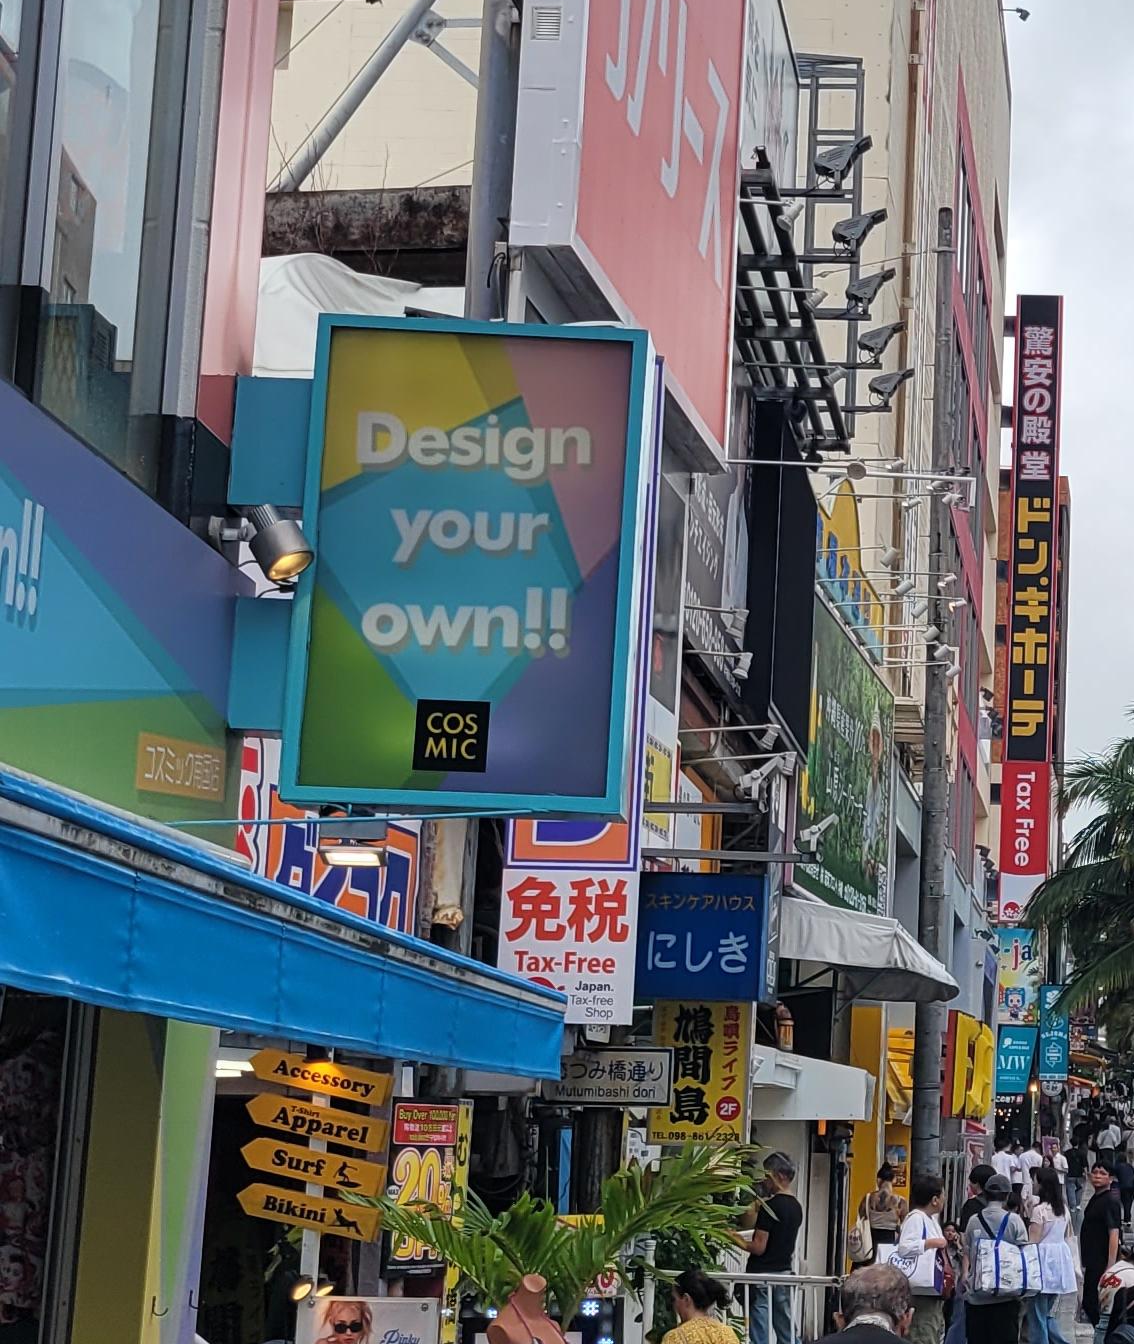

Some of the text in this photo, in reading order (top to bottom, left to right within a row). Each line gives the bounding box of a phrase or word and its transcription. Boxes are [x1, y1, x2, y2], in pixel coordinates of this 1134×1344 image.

[1019, 324, 1056, 482] 驚安の殿堂
[356, 410, 592, 482] Design
[390, 507, 550, 564] your
[360, 586, 569, 651] own!!
[426, 711, 479, 736] COS
[424, 736, 478, 761] MIC
[1014, 771, 1036, 868] Tax Free
[504, 875, 630, 944] 免税
[645, 892, 758, 913] スキンケアハウス
[513, 950, 617, 975] Tax-Free
[646, 931, 750, 975] にしき
[569, 994, 614, 1007] Tax-free
[574, 980, 615, 994] Japan.
[584, 1006, 614, 1021] Shop
[272, 1059, 376, 1099] Accessory
[632, 1085, 656, 1099] dori
[719, 1102, 739, 1116] 2F
[271, 1106, 370, 1144] Apparel
[271, 1148, 327, 1177] Surf
[262, 1194, 327, 1224] Bikini
